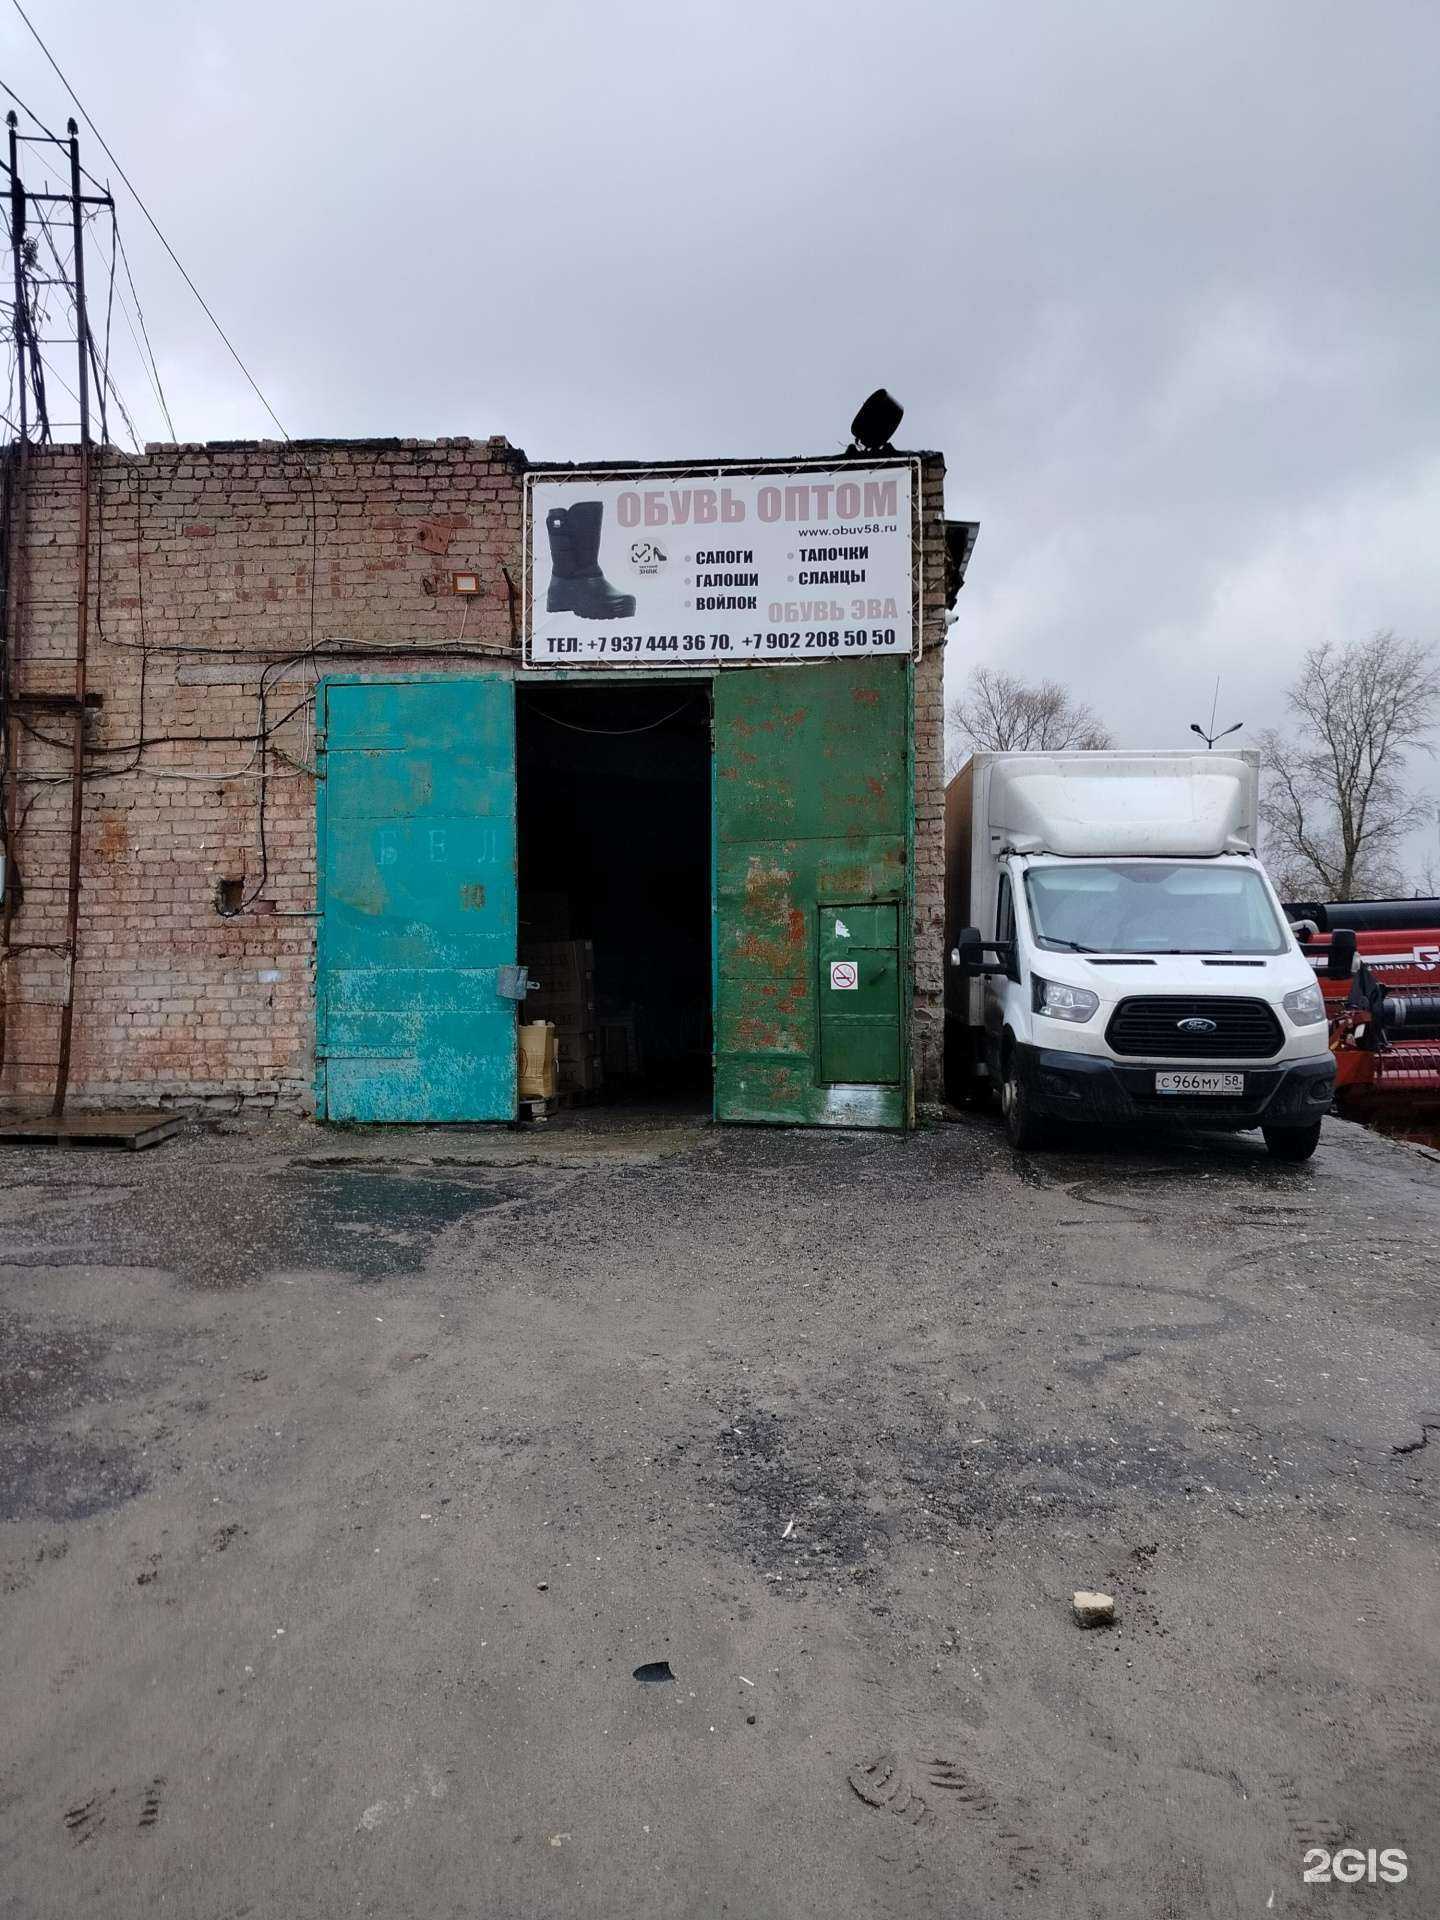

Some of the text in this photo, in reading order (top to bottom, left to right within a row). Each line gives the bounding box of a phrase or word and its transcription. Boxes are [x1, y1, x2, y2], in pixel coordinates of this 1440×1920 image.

[617, 481, 898, 528] ОБУВЬ ОПТОМ
[798, 524, 897, 537] www.obuv58.ru
[696, 550, 754, 565] САПОГИ
[799, 546, 870, 563] ТАПОЧКИ
[696, 573, 759, 588] ГАЛОШИ
[798, 569, 866, 586] СЛАНЦЫ
[696, 594, 757, 611] ВОЙЛОК
[768, 598, 898, 623] ОБУВЬ ЭВА
[547, 628, 896, 653] ТЕЛ: +7 937 444 36 70, +7 902 208 50 50
